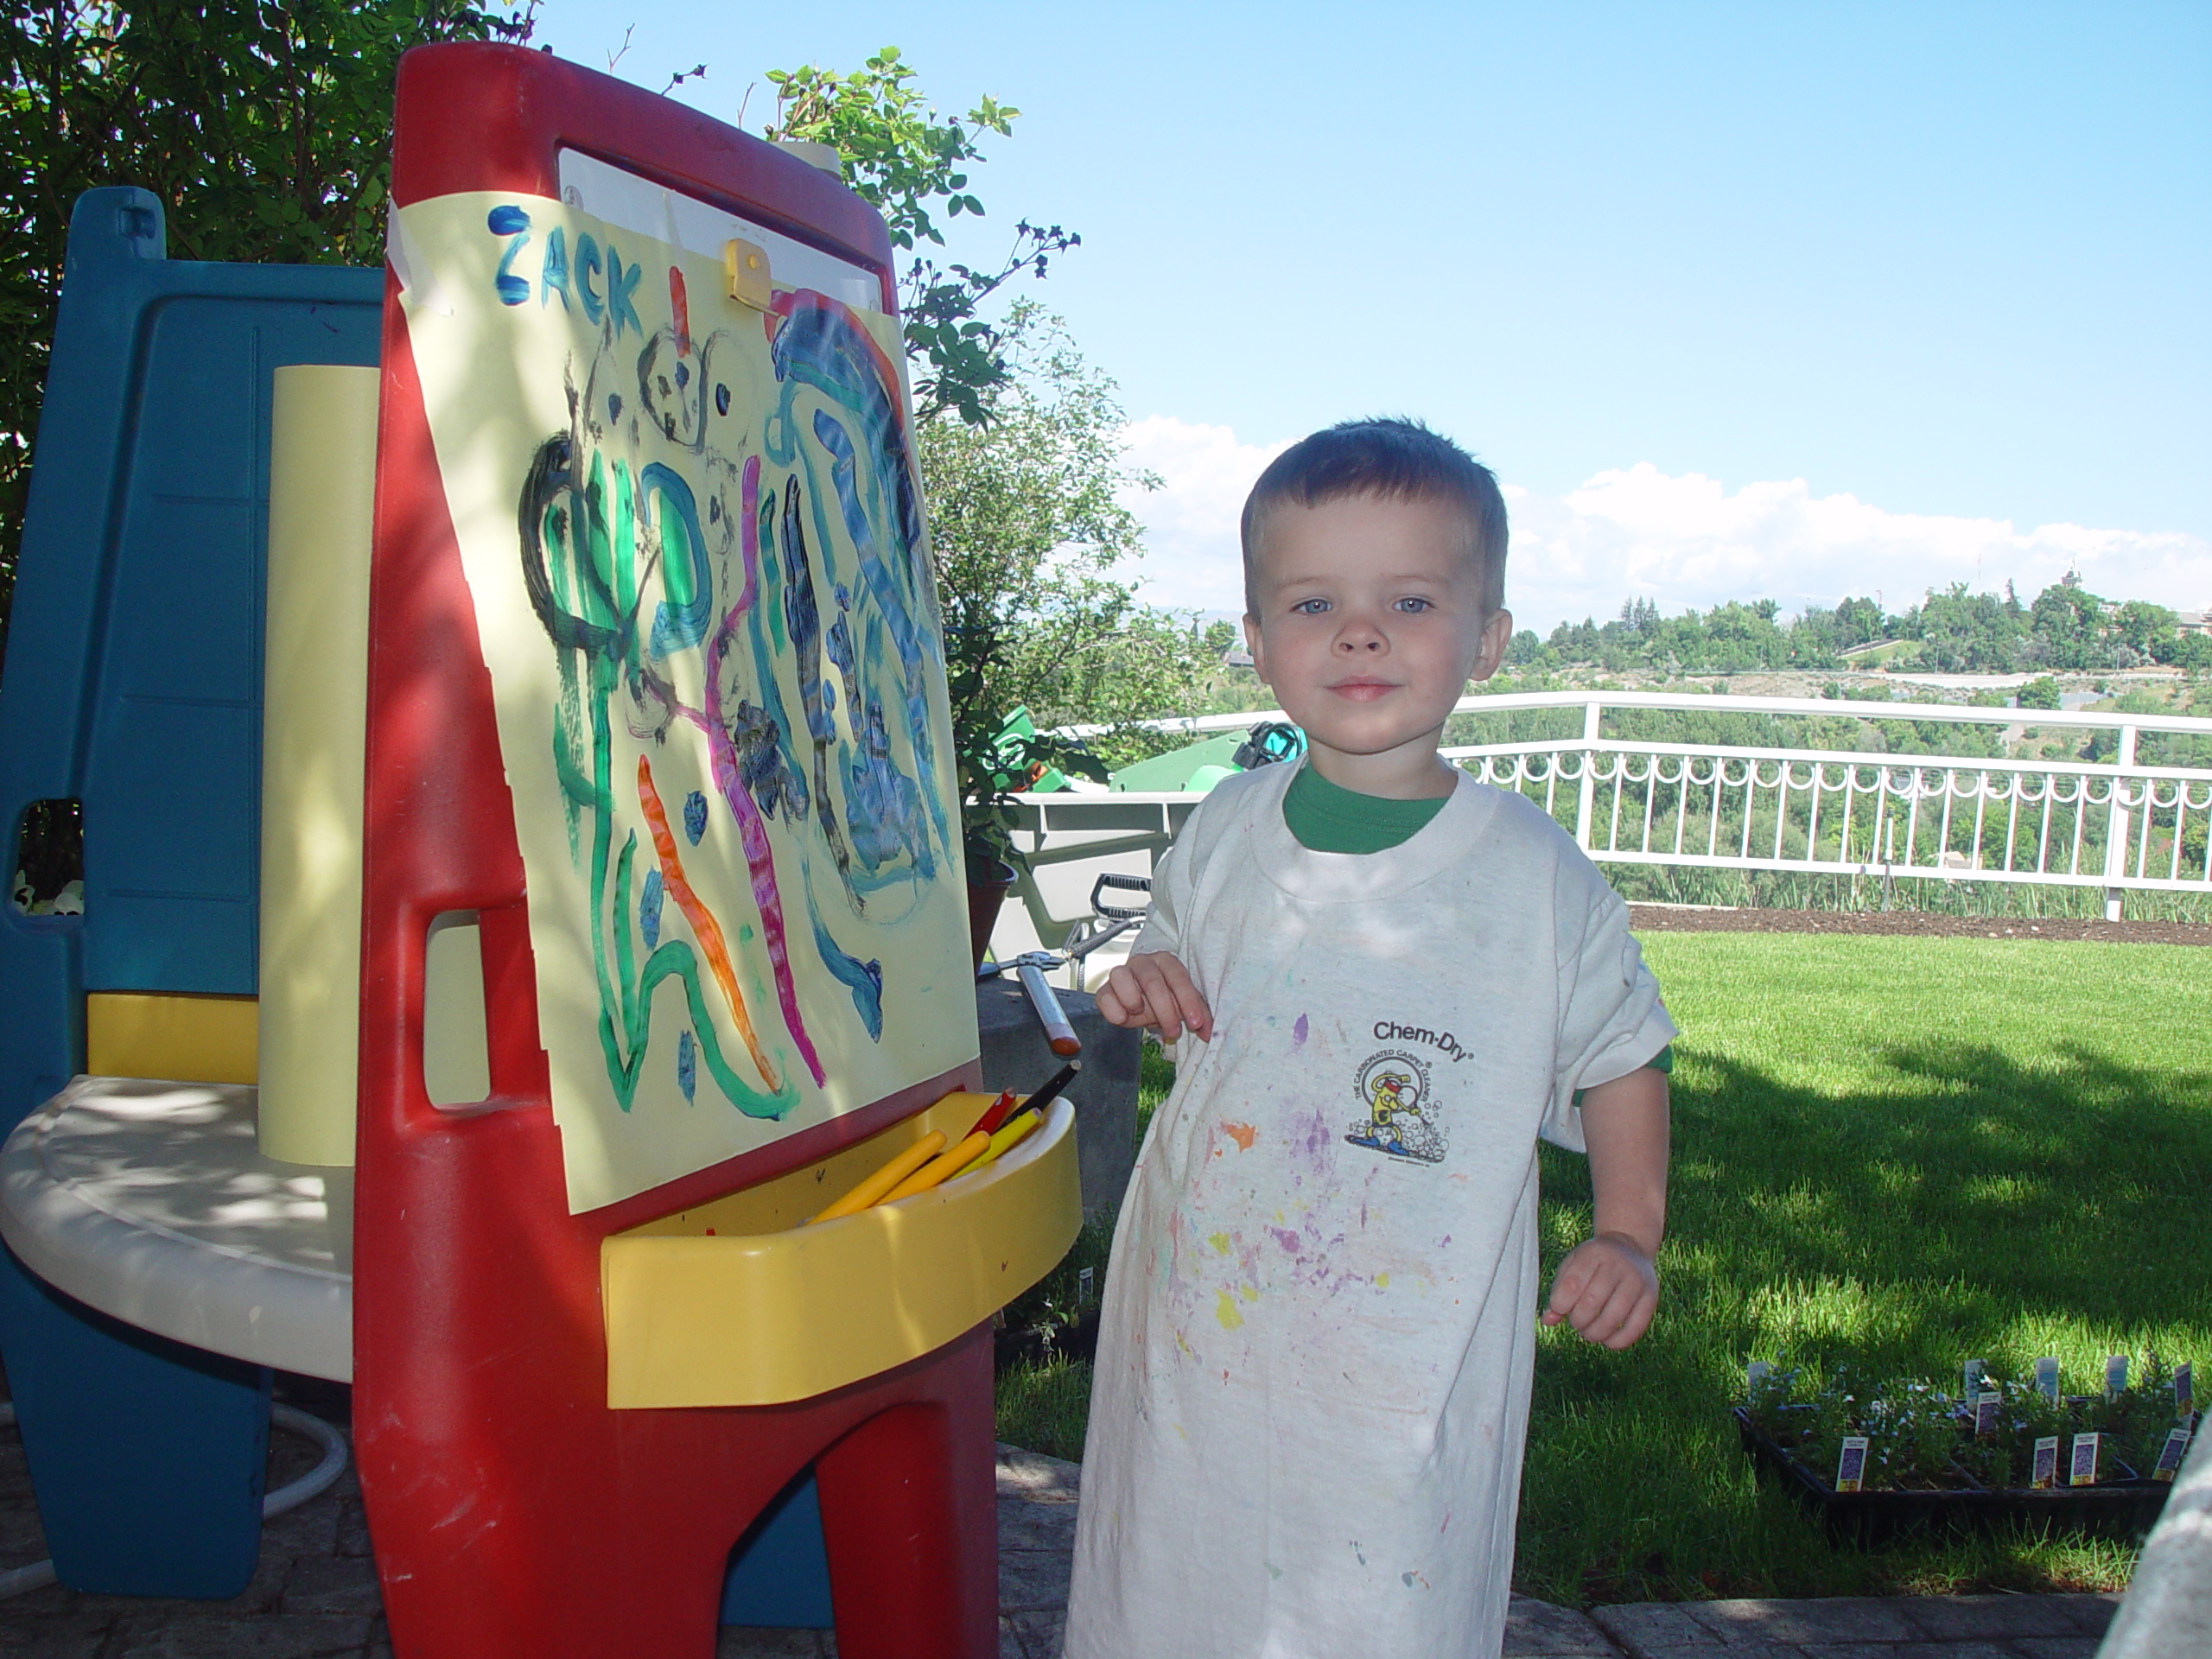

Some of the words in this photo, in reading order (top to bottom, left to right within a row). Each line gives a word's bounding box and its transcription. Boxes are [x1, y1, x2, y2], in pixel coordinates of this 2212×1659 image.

[487, 205, 645, 343] ZACK
[1353, 1049, 1395, 1084] CARBONATED
[1353, 1085, 1363, 1099] THE
[1421, 1069, 1432, 1102] CLEANER
